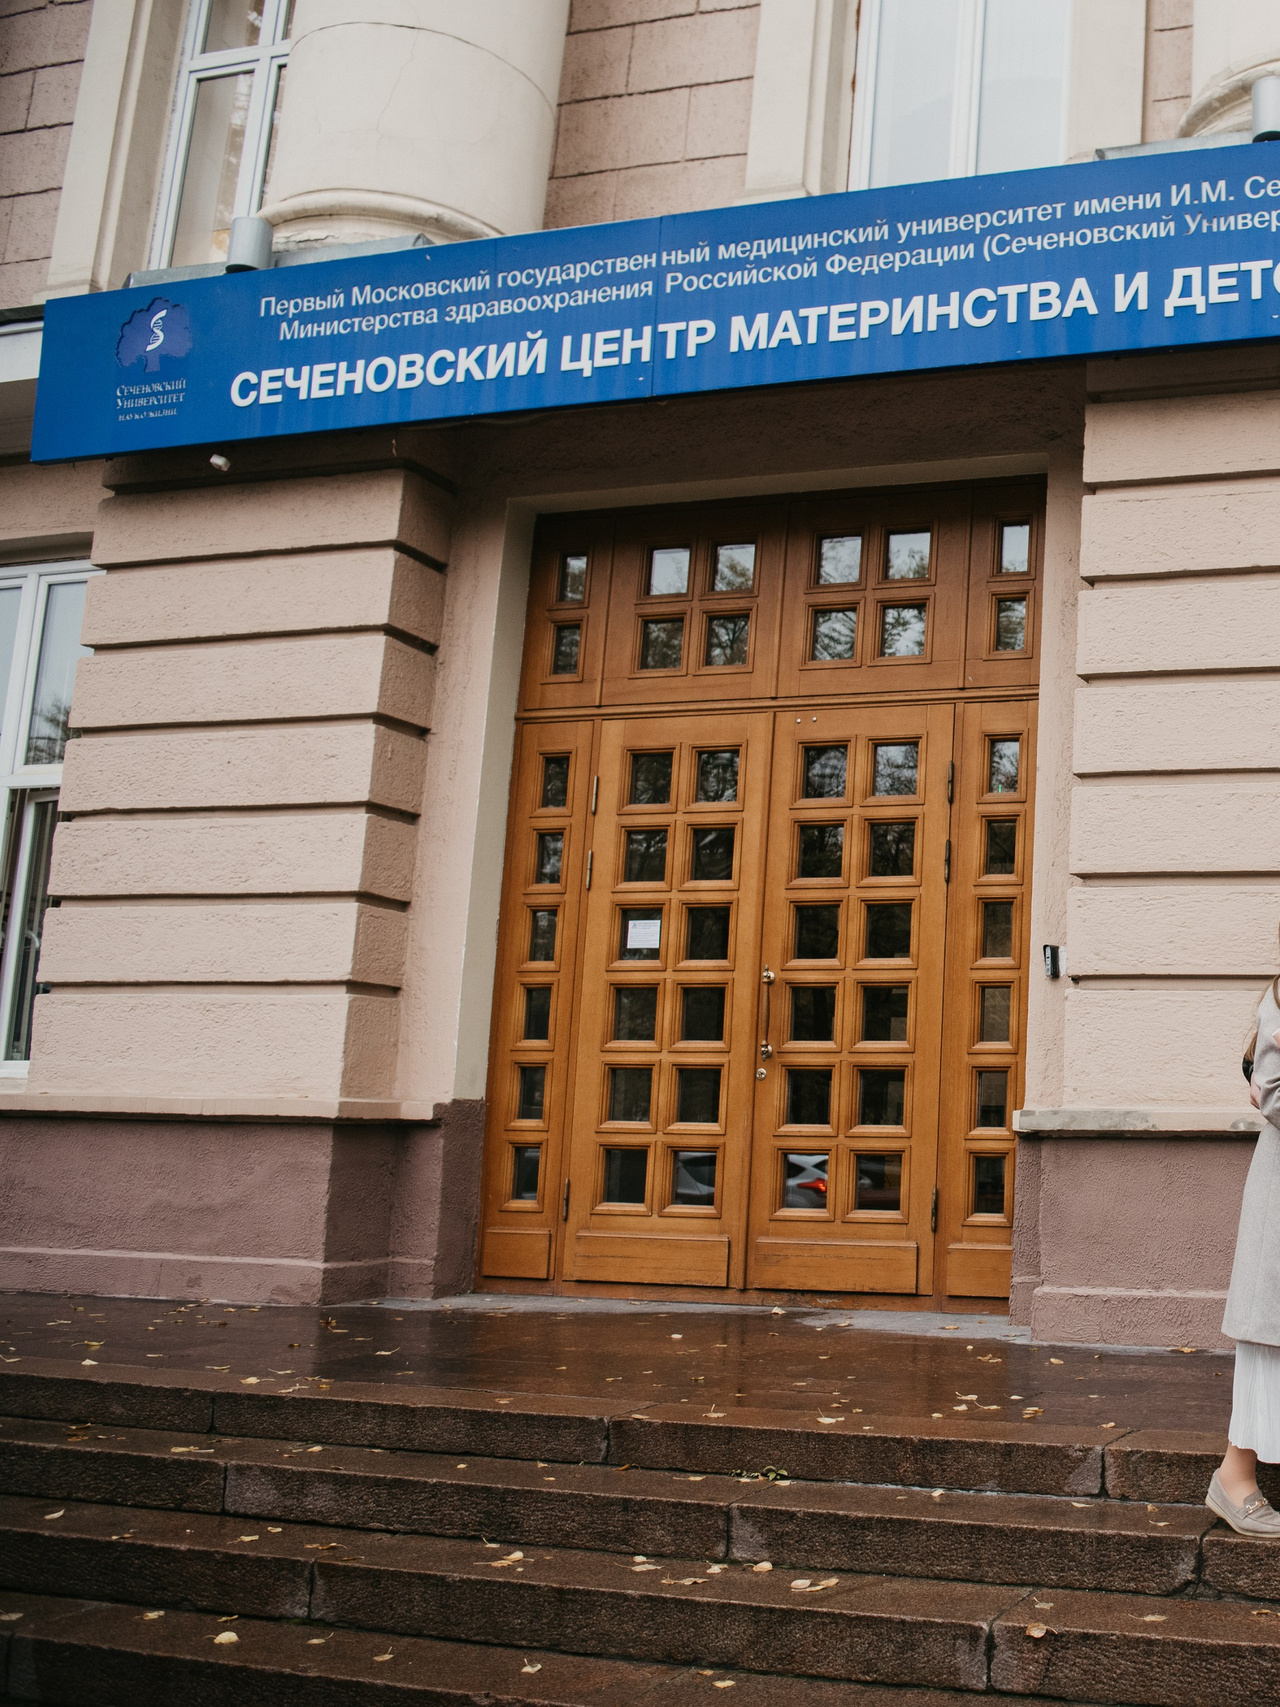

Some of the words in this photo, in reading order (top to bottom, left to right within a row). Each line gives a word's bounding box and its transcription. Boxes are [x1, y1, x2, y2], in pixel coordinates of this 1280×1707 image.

[260, 288, 345, 317] Первый
[351, 269, 490, 306] Московский
[497, 241, 710, 289] государственный
[717, 224, 889, 261] медицинский
[896, 202, 1067, 244] университет
[1073, 191, 1161, 217] имени
[1170, 179, 1237, 207] И.М.
[279, 307, 438, 341] Министерства
[444, 280, 653, 325] здравоохранения
[665, 256, 818, 294] Российской
[825, 242, 975, 276] Федерации
[982, 214, 1175, 262] (Сеченовский
[230, 329, 548, 407] СЕЧЕНОВСКИЙ
[560, 318, 716, 378] ЦЕНТР
[729, 276, 1099, 353] МАТЕРИНСТВА
[1114, 270, 1149, 313] И
